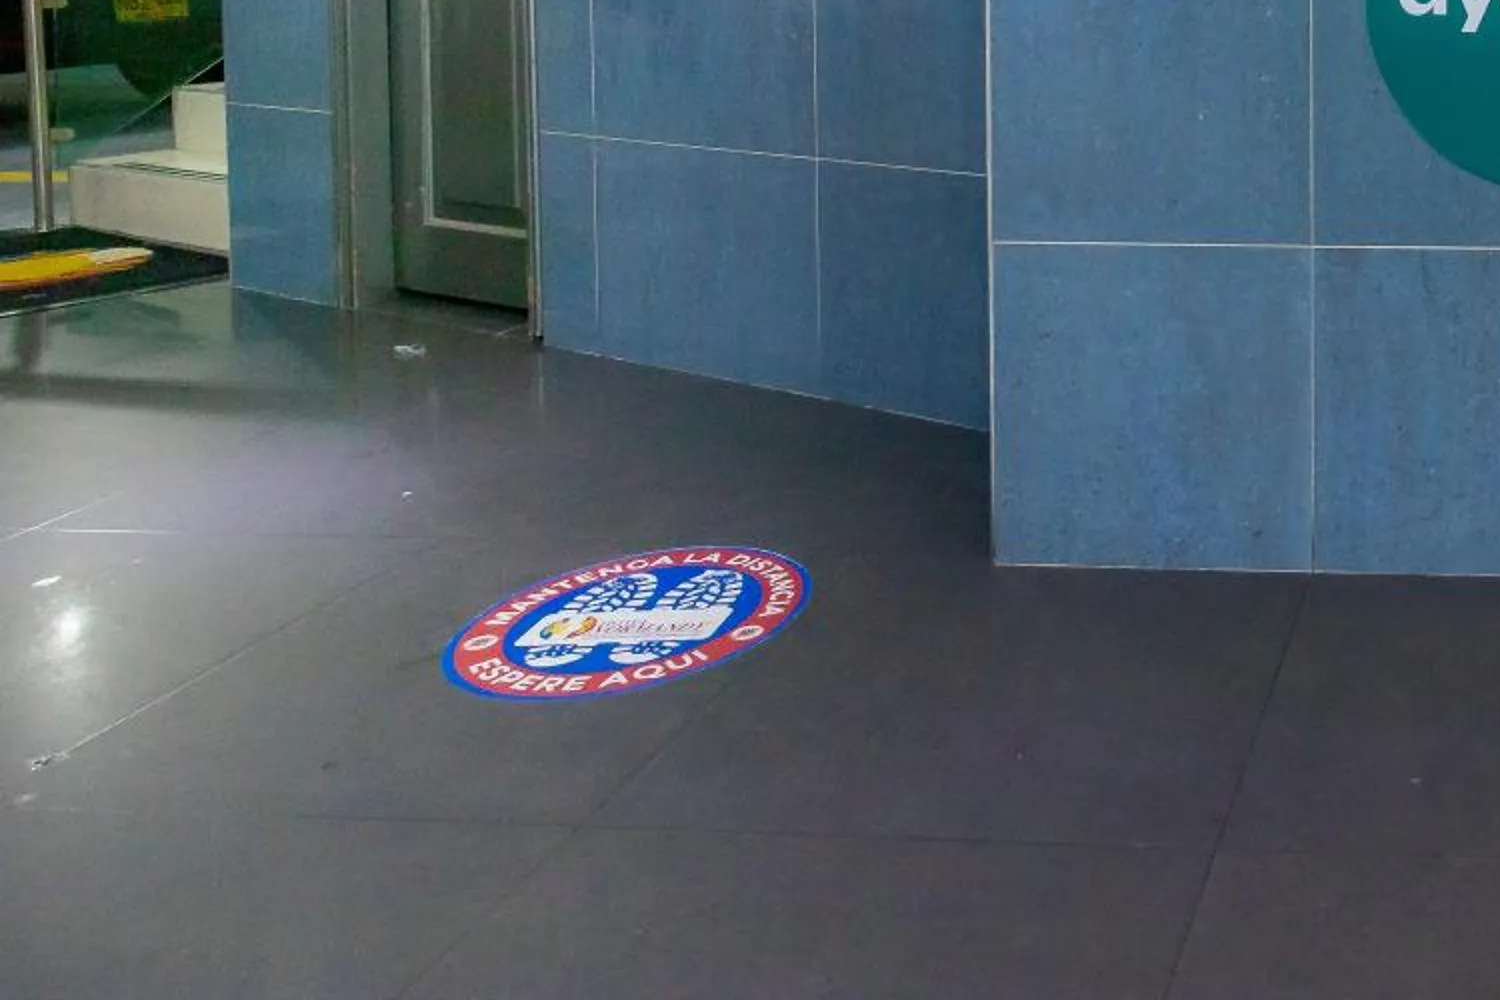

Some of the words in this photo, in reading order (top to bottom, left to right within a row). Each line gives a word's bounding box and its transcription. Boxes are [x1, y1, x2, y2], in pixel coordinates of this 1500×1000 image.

[485, 555, 674, 625] MANTENGA
[683, 552, 721, 564] LA
[725, 554, 795, 617] DISTANCIA
[469, 657, 592, 692] ESPERE
[599, 649, 709, 688] AQUI
